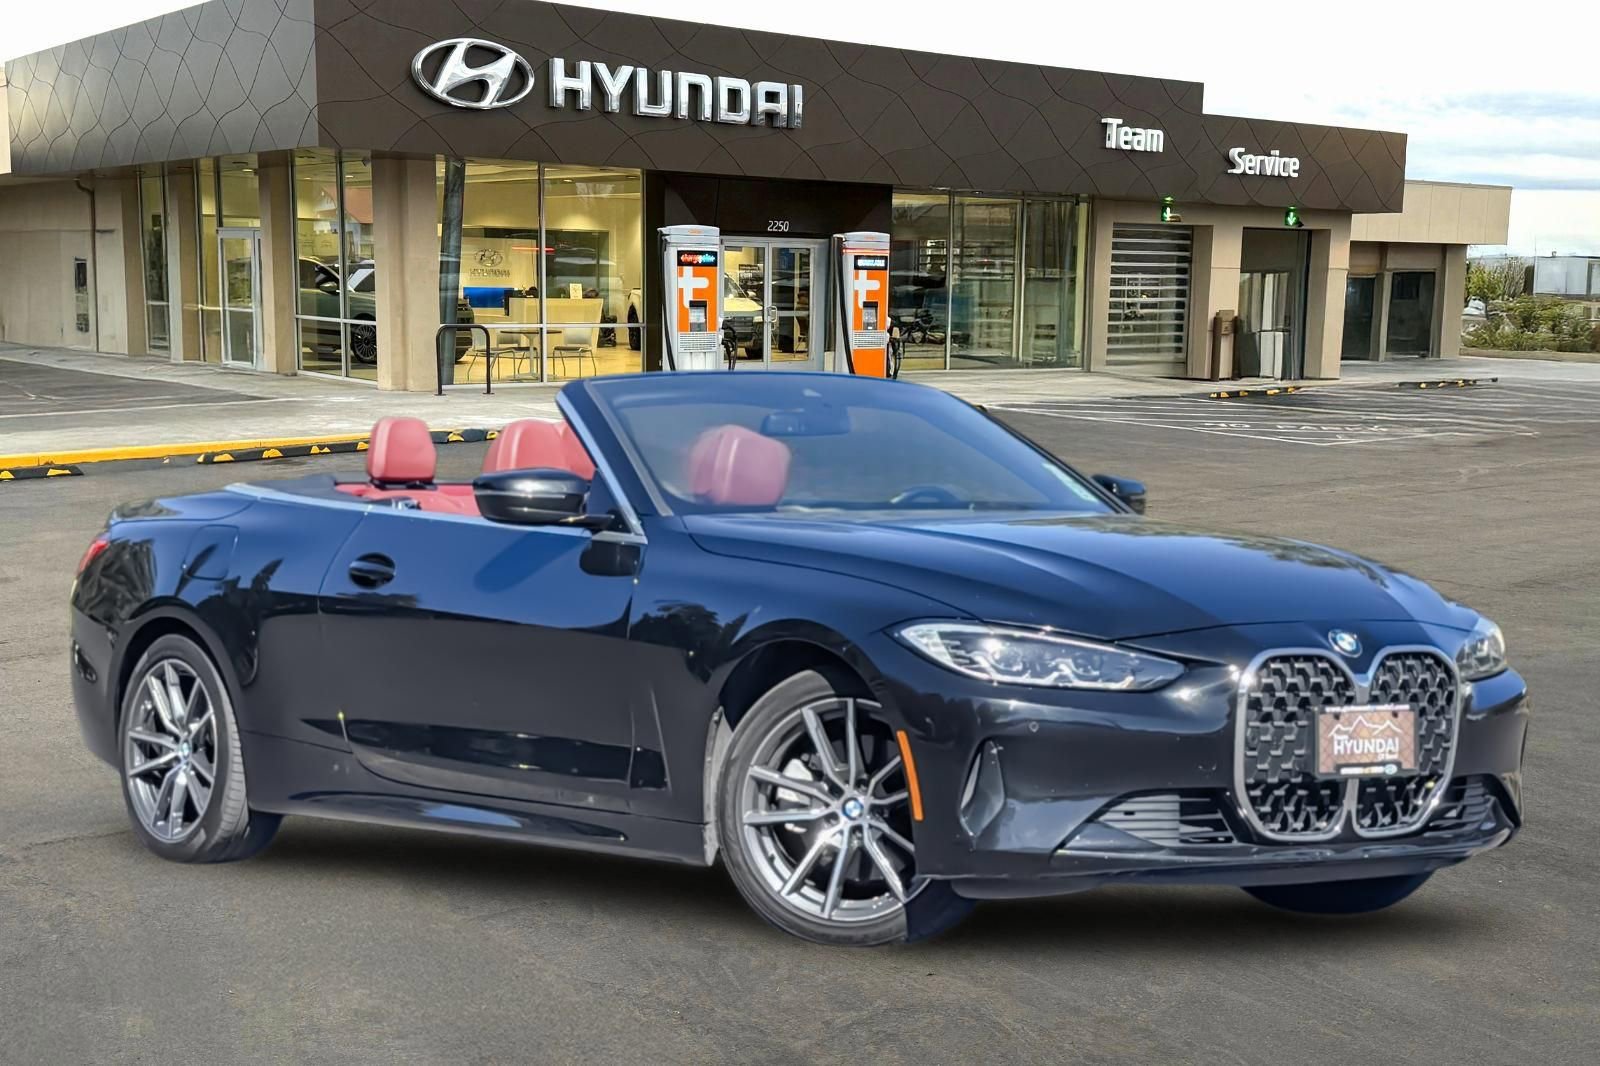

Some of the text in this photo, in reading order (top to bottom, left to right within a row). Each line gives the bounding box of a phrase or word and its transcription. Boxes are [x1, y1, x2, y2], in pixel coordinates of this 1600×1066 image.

[549, 57, 803, 129] HYUNDAI
[1101, 117, 1164, 153] Team
[1227, 147, 1300, 178] Service
[767, 220, 790, 232] 2250
[1333, 737, 1399, 756] HYUNDAI
